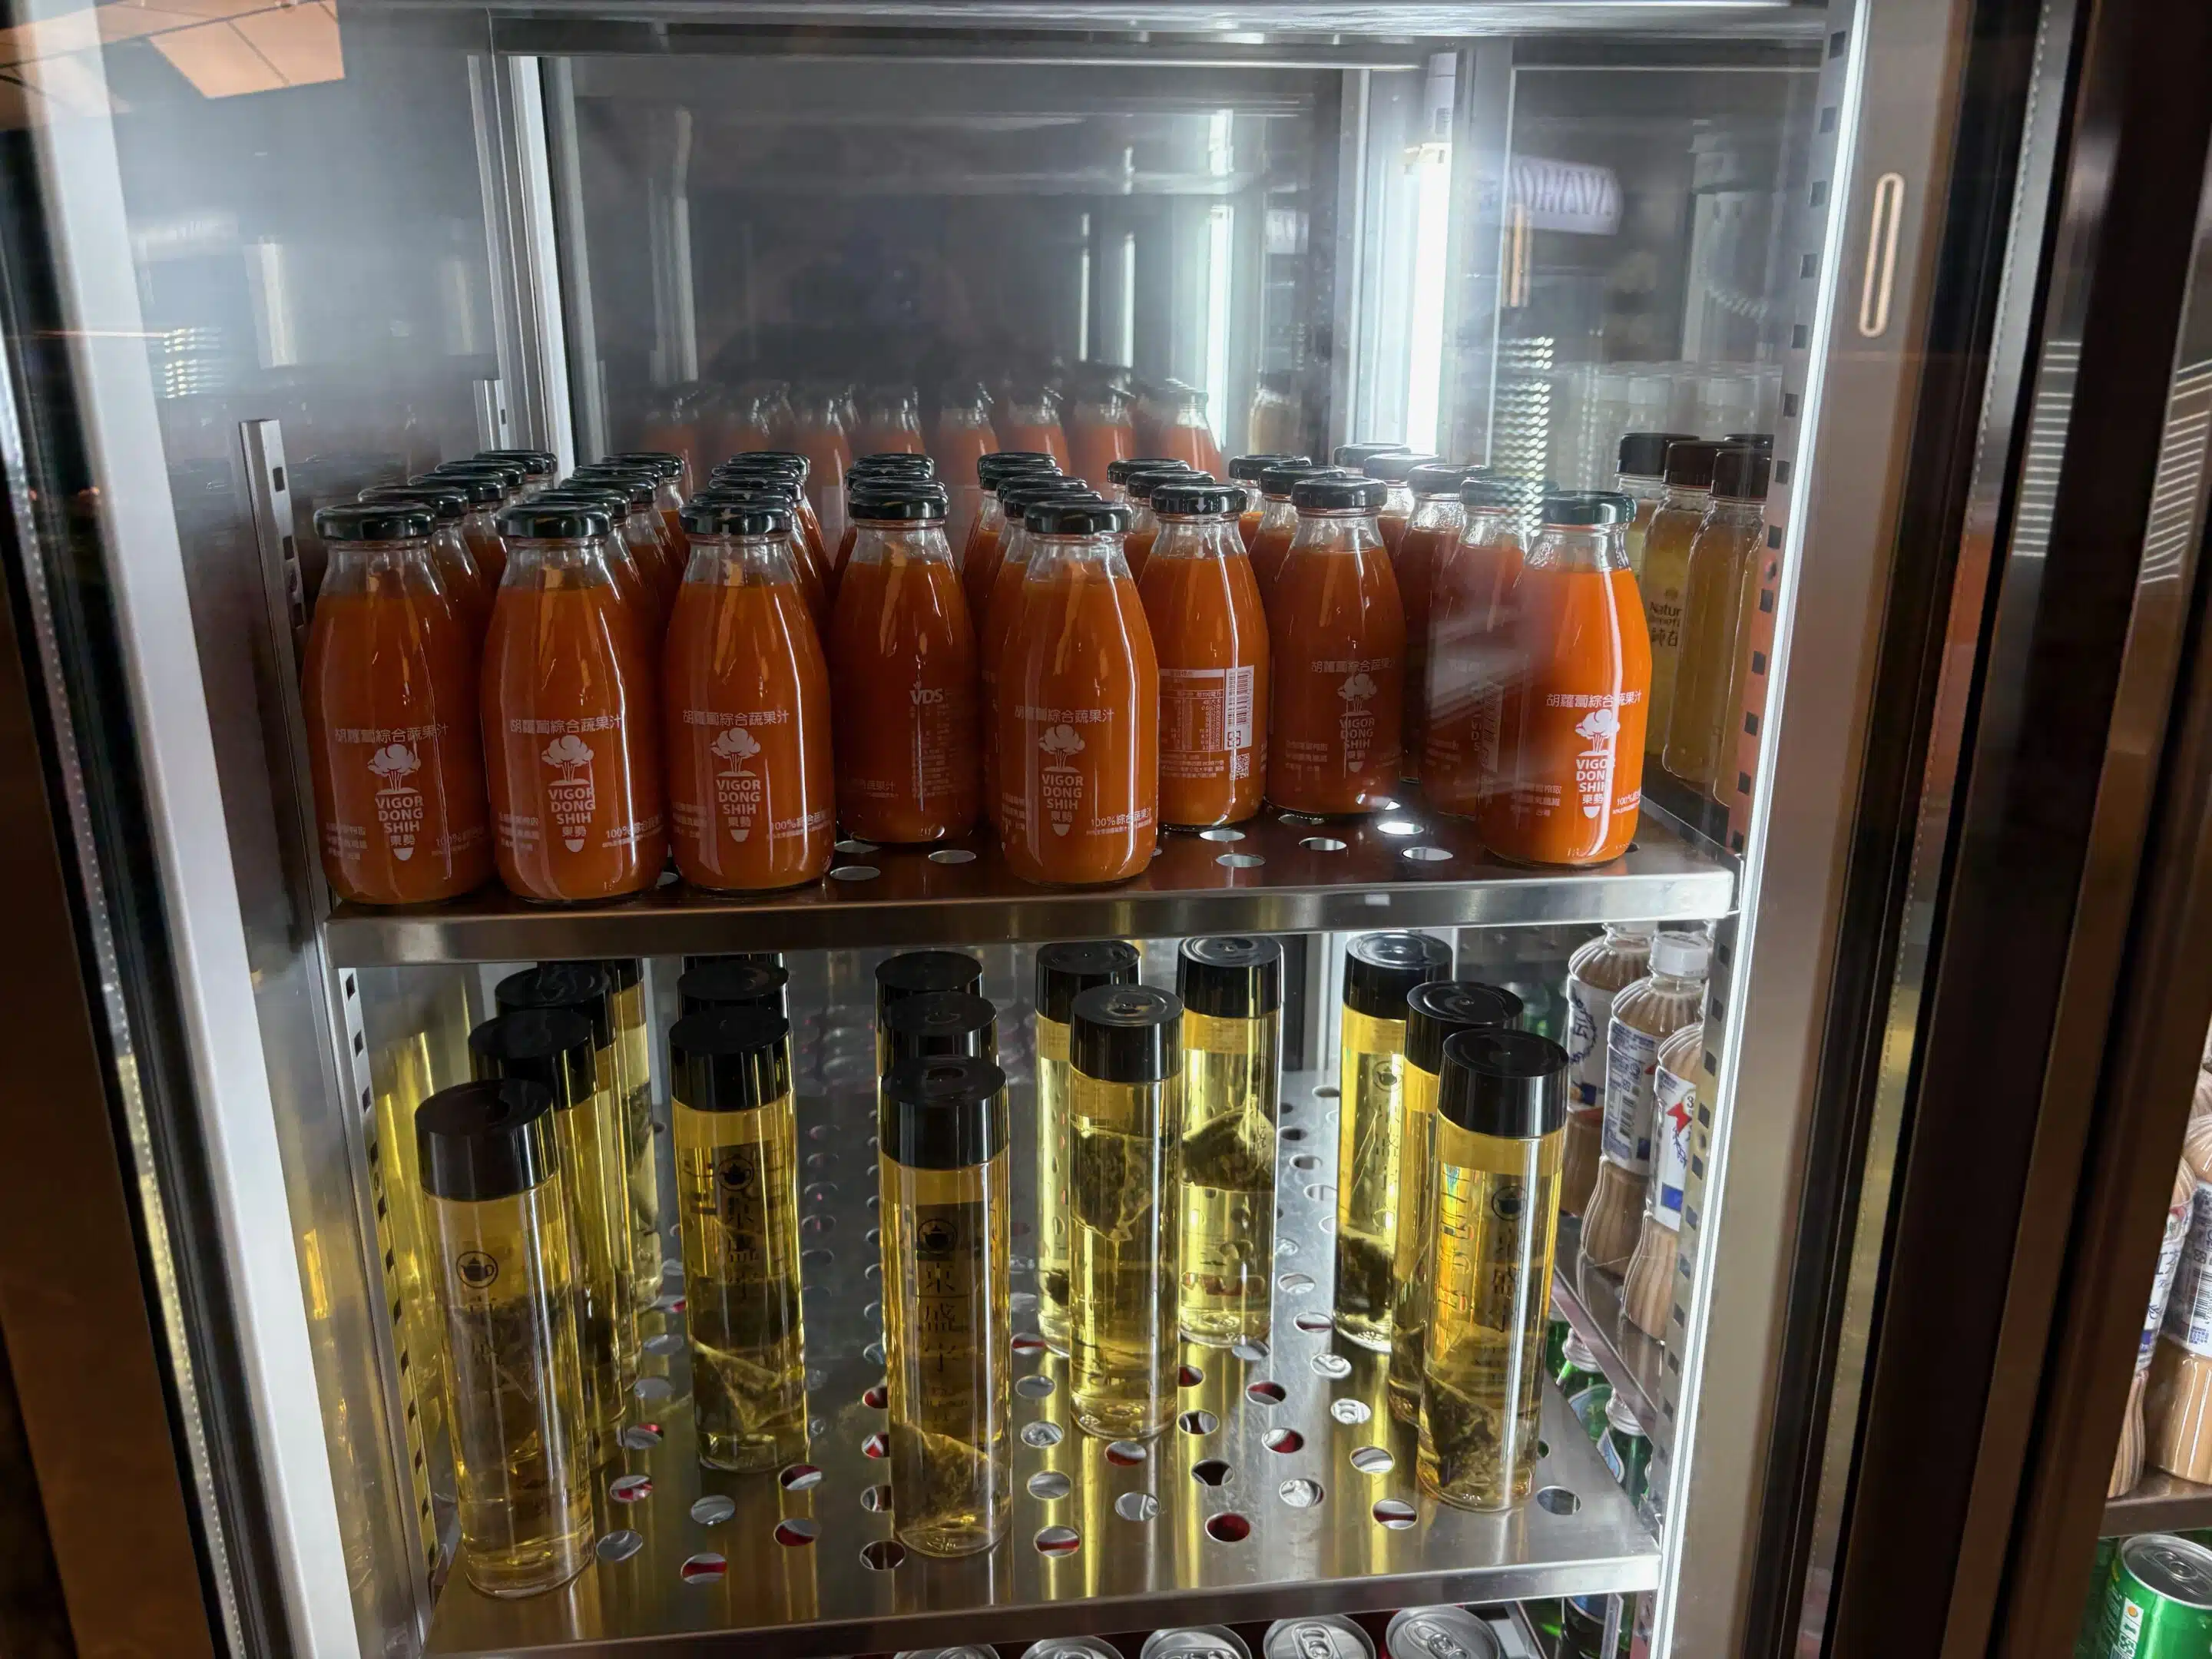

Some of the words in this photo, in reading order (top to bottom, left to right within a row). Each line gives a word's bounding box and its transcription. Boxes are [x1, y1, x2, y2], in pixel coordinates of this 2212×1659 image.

[1041, 773, 1084, 786] VIGOR
[1576, 770, 1611, 781] DON
[716, 779, 761, 791] VIGOR
[548, 787, 594, 800] VIGOR
[718, 791, 761, 803] DONG
[1043, 786, 1082, 798] DONG
[375, 796, 424, 809] VIGOR
[551, 800, 595, 813] DONG
[1046, 799, 1078, 810] SHIH
[723, 803, 757, 815] SHIH
[378, 809, 424, 822] DONG
[556, 812, 592, 825] SHIH
[384, 821, 420, 833] SHIH
